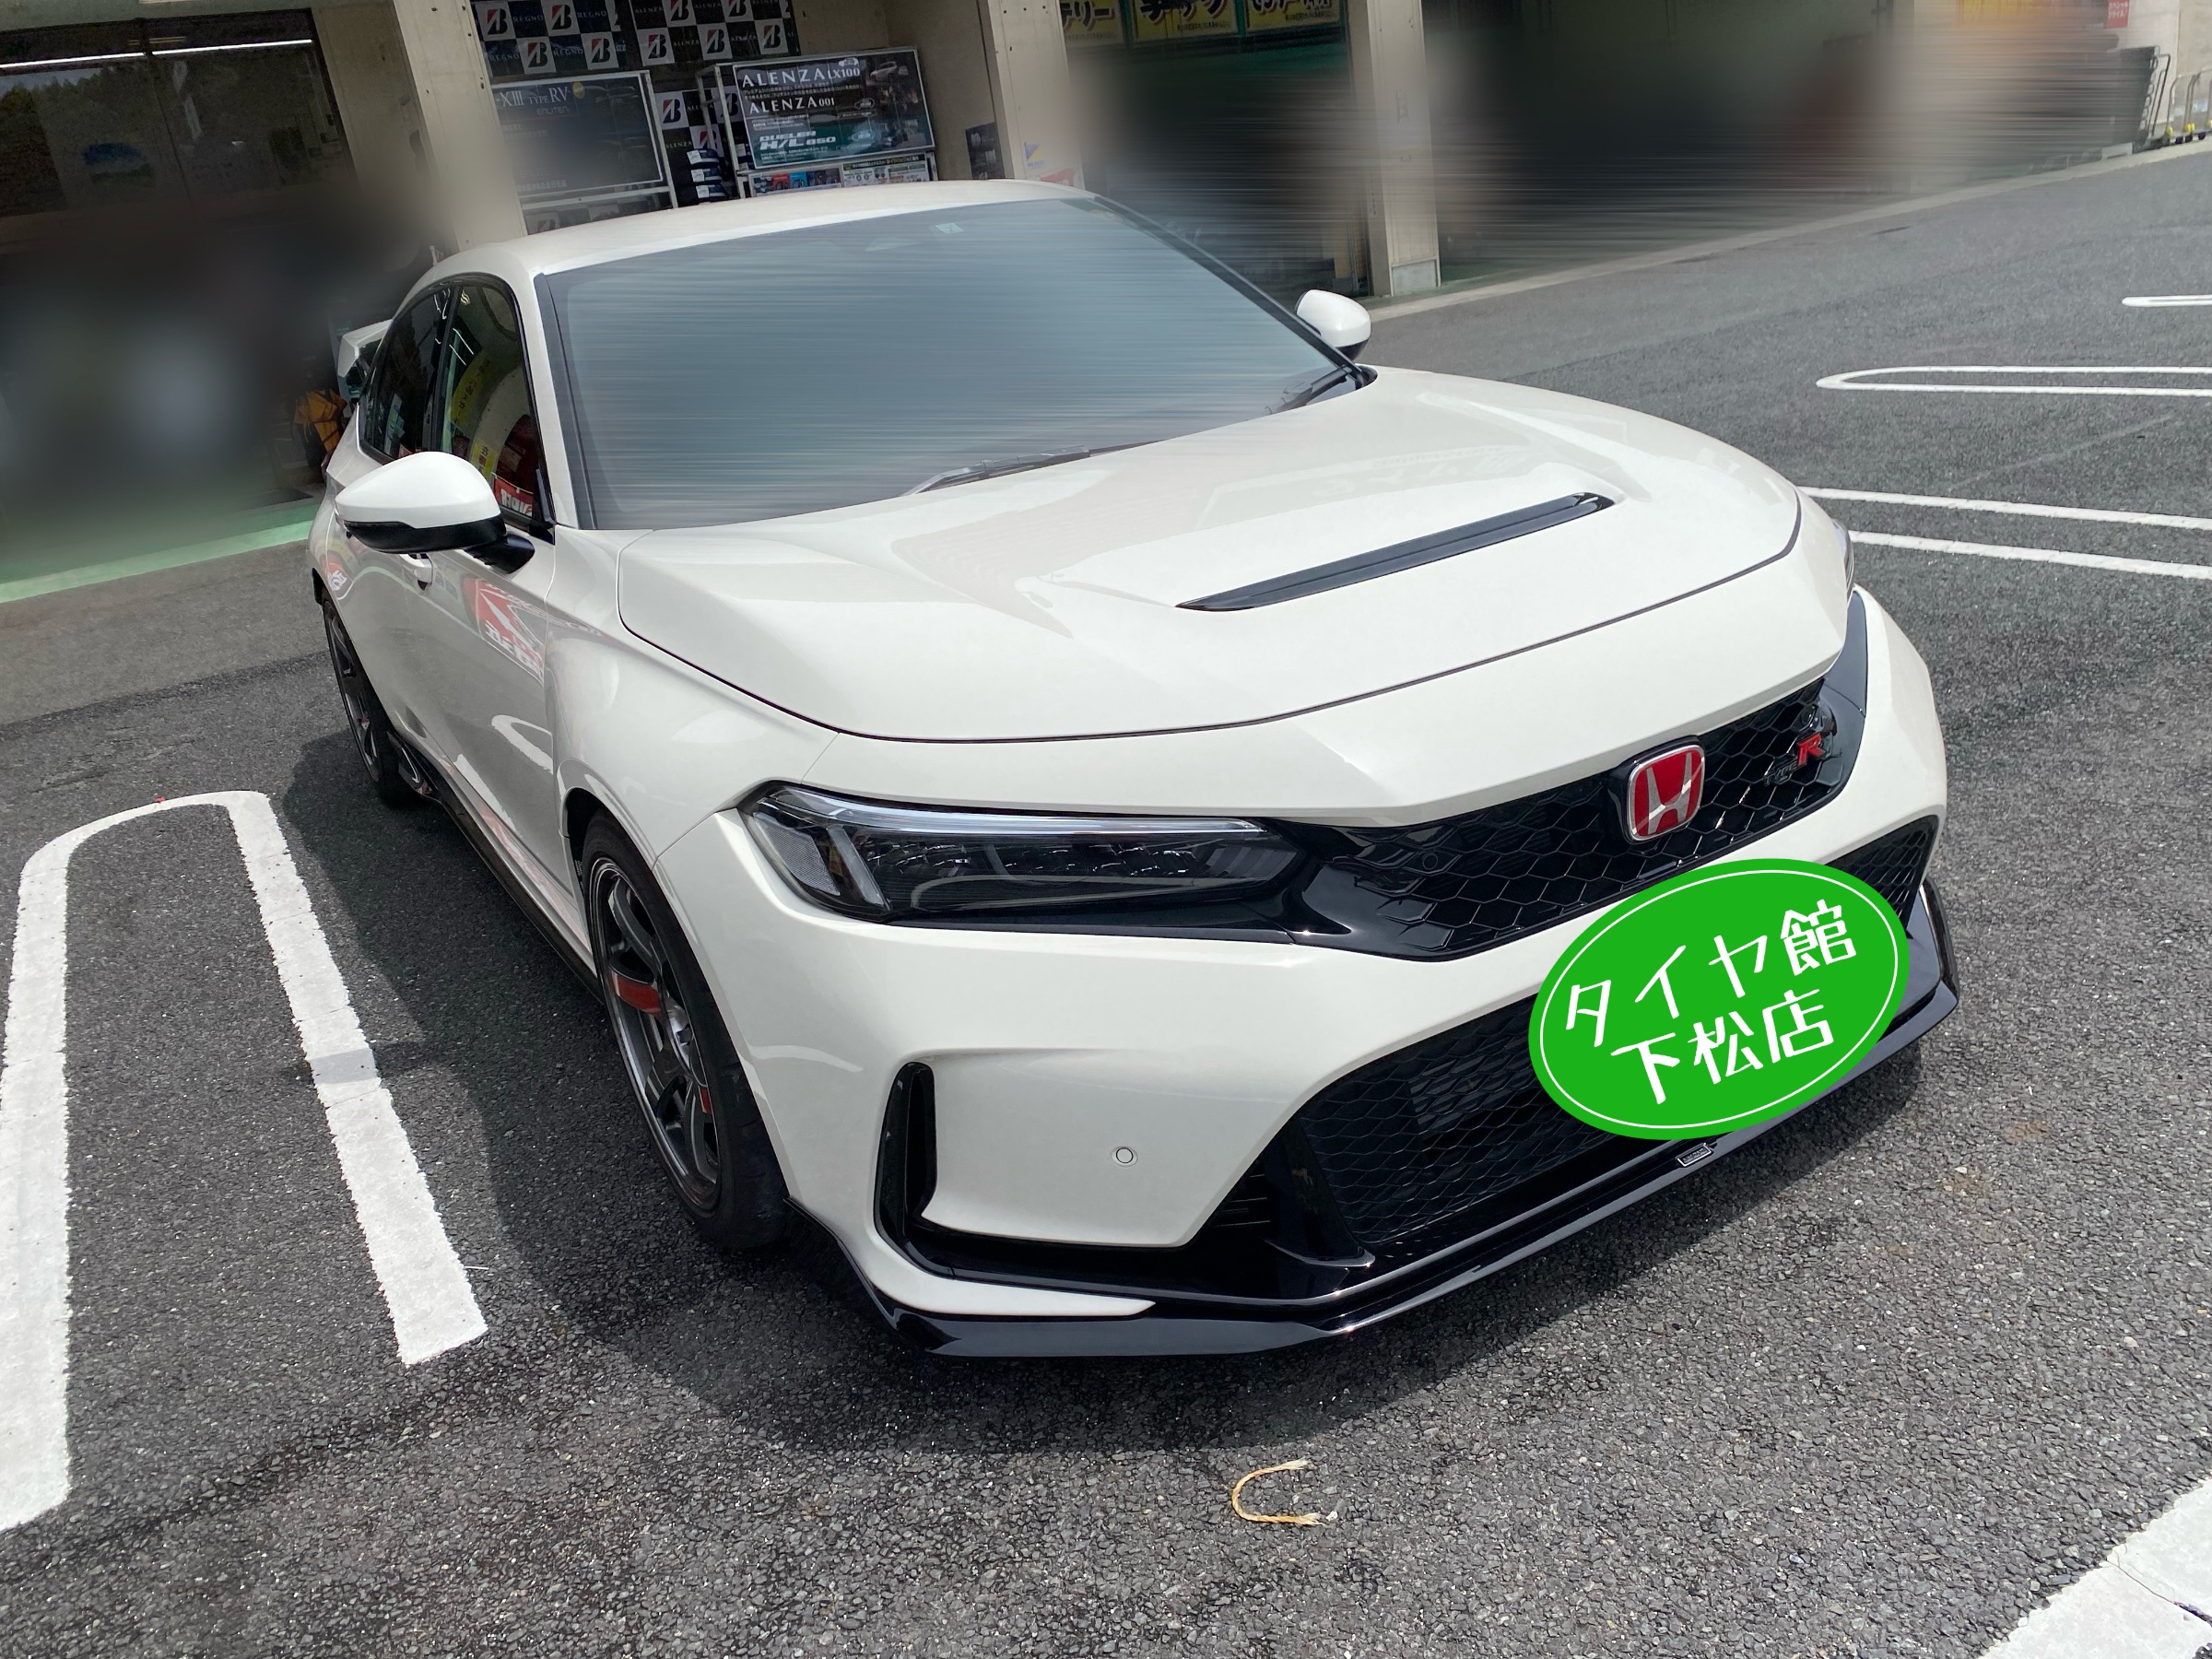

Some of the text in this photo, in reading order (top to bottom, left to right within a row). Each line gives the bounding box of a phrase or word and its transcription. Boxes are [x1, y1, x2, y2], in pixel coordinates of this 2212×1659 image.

[512, 14, 544, 22] REGNO
[577, 10, 607, 18] REGNO
[742, 67, 861, 88] ALENZA LX100
[529, 94, 548, 105] TYPE
[548, 86, 568, 103] RV
[749, 97, 835, 114] ALENZA 001
